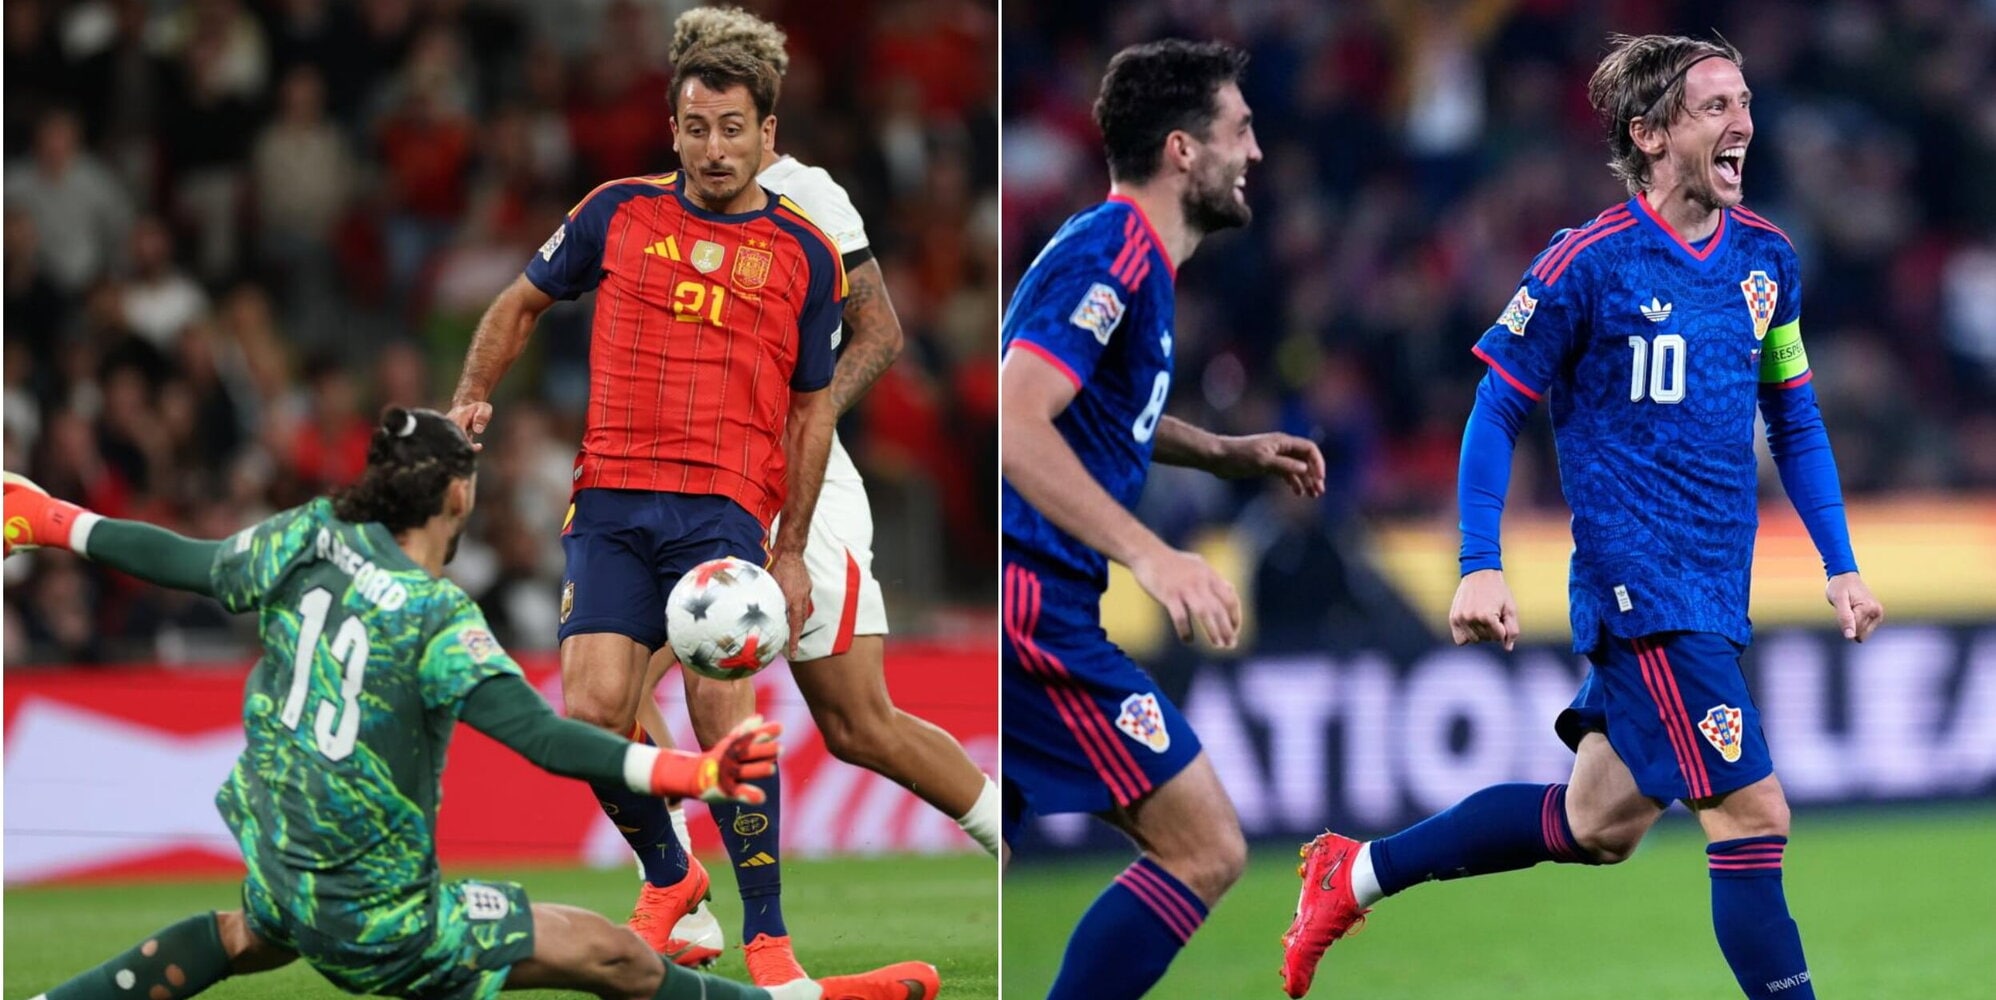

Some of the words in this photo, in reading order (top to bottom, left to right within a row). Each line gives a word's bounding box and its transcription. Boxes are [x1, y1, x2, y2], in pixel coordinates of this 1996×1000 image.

[673, 281, 725, 327] 21
[1629, 334, 1687, 404] 10
[1132, 370, 1170, 443] 8
[281, 587, 370, 762] 13
